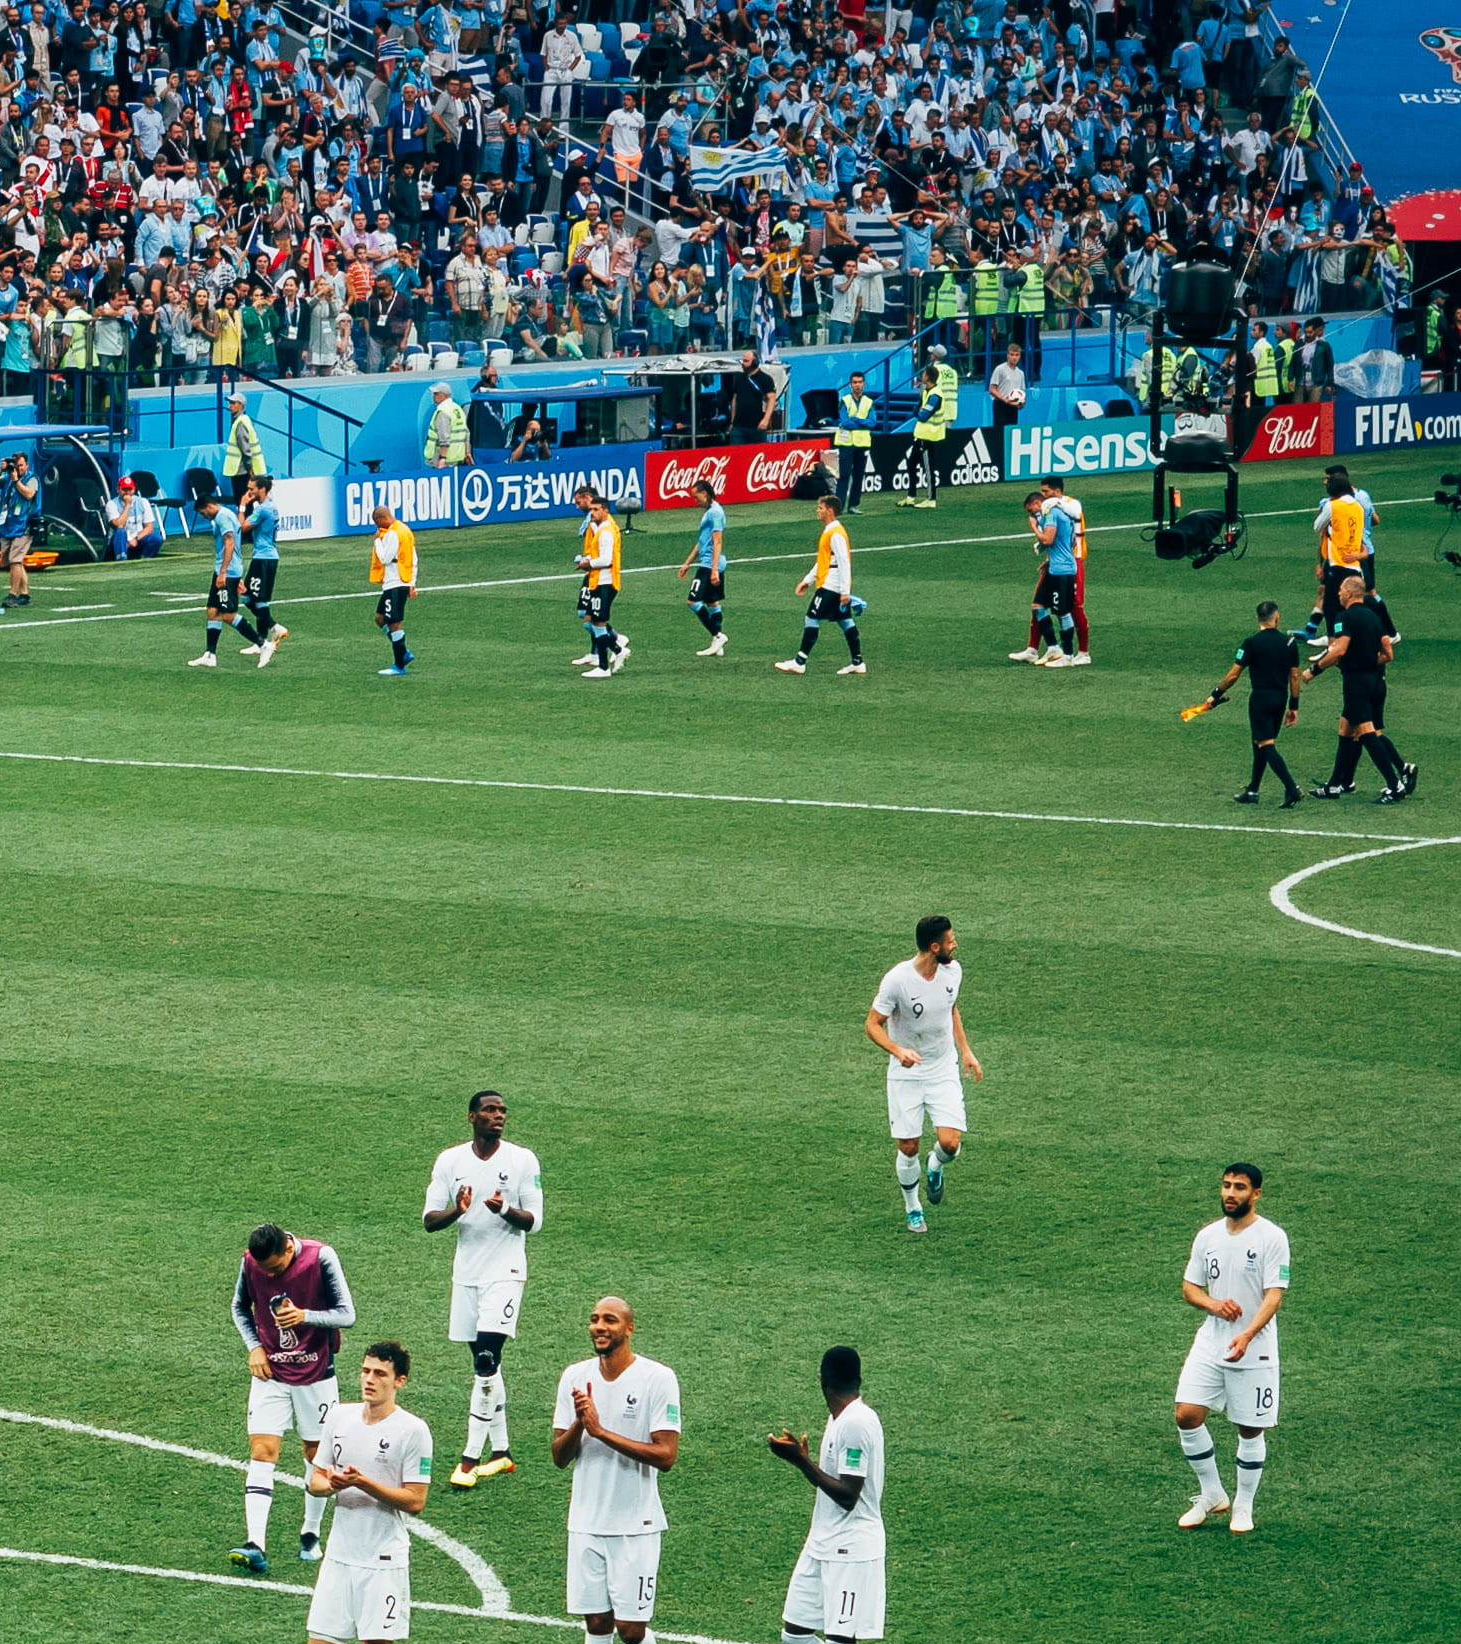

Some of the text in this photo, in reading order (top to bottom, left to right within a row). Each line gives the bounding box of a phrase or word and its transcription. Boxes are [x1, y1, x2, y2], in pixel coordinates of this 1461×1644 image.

[1399, 93, 1461, 104] RUS
[1264, 415, 1319, 454] Bud
[950, 463, 999, 486] adidas
[496, 467, 642, 511] 万达 WANDA
[346, 475, 451, 527] GAZPROM
[250, 577, 261, 591] 22
[217, 589, 228, 603] 18
[384, 599, 392, 612] 5
[590, 597, 601, 611] 10
[815, 596, 822, 609] 4
[1053, 592, 1059, 604] 2
[912, 1002, 924, 1019] 9
[1205, 1257, 1220, 1280] 18
[503, 1298, 514, 1319] 6
[1256, 1386, 1273, 1409] 18
[334, 1443, 344, 1468] 2
[638, 1575, 654, 1601] 15
[385, 1594, 396, 1620] 2
[841, 1590, 856, 1617] 11
